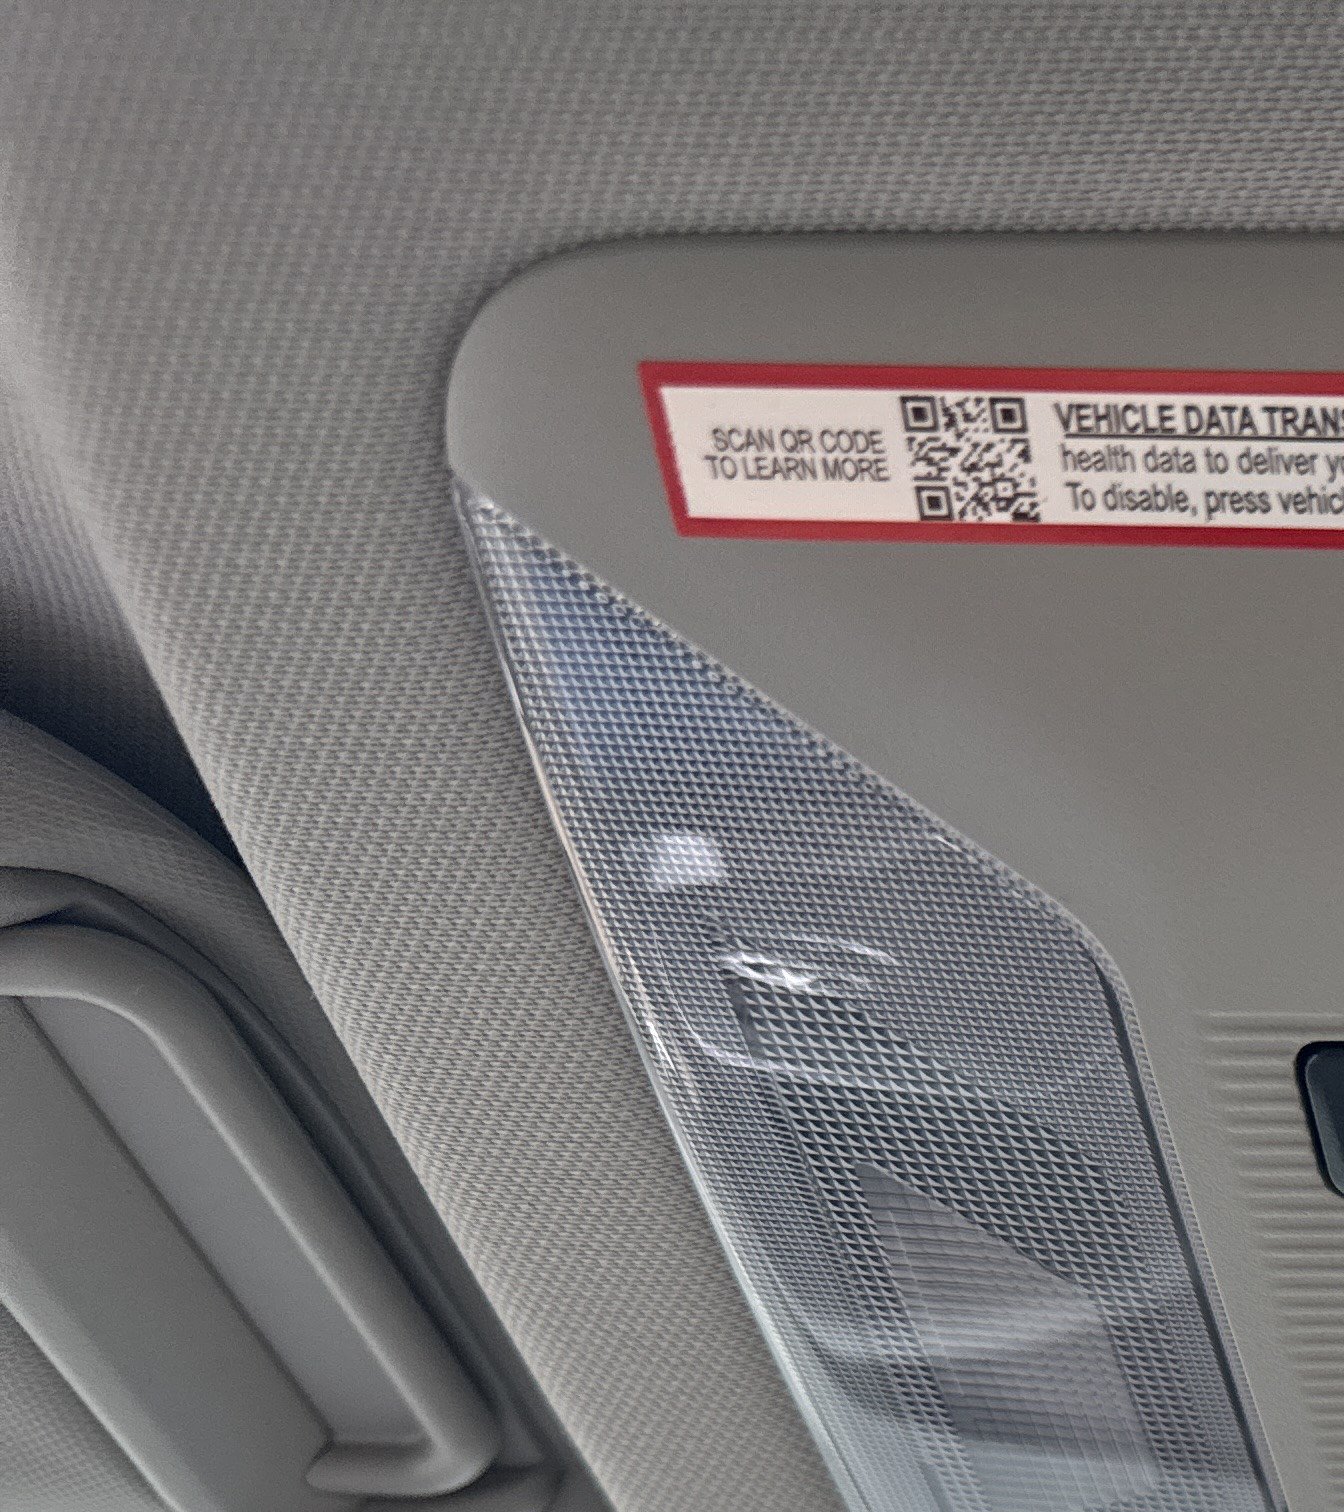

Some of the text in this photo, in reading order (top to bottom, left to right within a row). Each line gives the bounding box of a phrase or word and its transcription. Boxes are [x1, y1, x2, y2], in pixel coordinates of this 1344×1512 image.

[1054, 402, 1176, 433] VEHICLE
[1184, 403, 1258, 434] DATA
[712, 427, 885, 455] SCAN QR CODE
[704, 455, 890, 483] TO LEARN MORE
[1060, 441, 1136, 473] health
[1144, 445, 1196, 474] data
[1204, 448, 1228, 474] to
[1238, 447, 1318, 476] deliver
[1065, 482, 1096, 511] To
[1103, 483, 1197, 516] disable,
[1204, 490, 1271, 518] press
